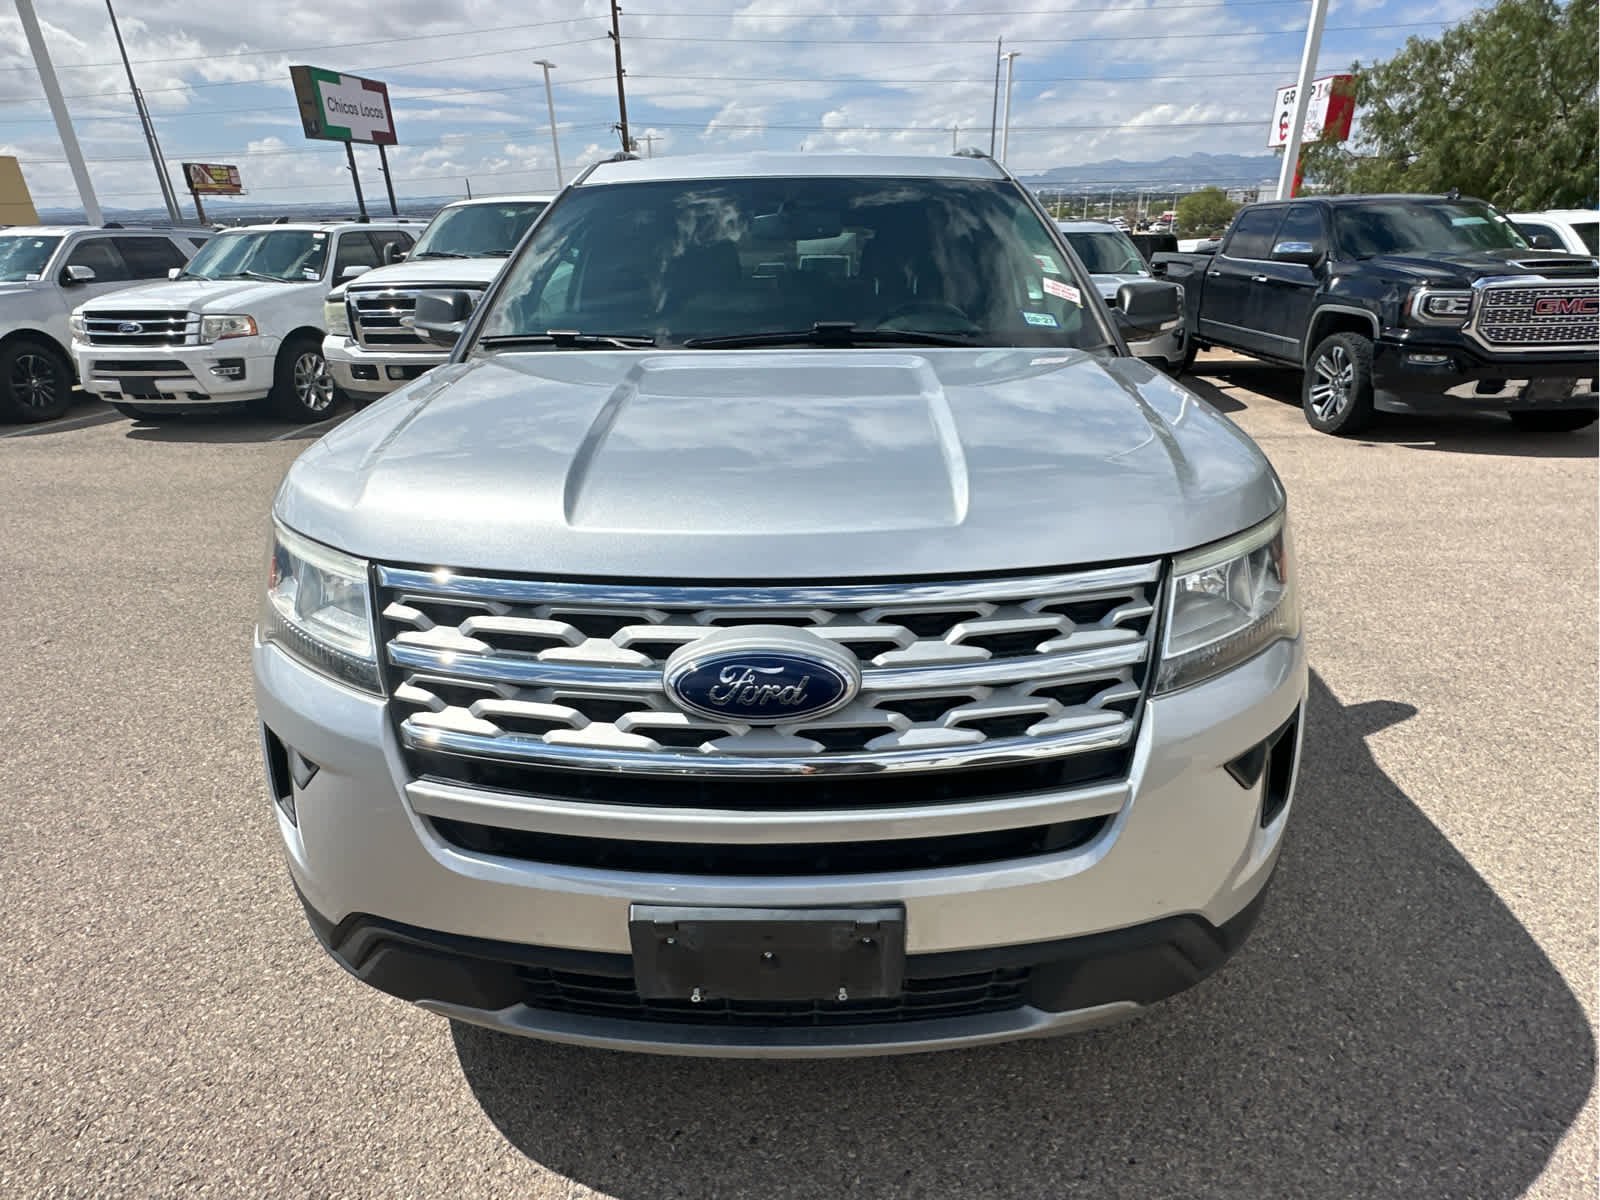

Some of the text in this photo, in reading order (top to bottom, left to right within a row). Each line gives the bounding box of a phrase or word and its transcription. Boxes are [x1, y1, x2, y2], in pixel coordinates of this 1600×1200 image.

[327, 96, 384, 119] Chicas Locas
[1535, 298, 1598, 314] GMC
[709, 665, 810, 706] Ford
